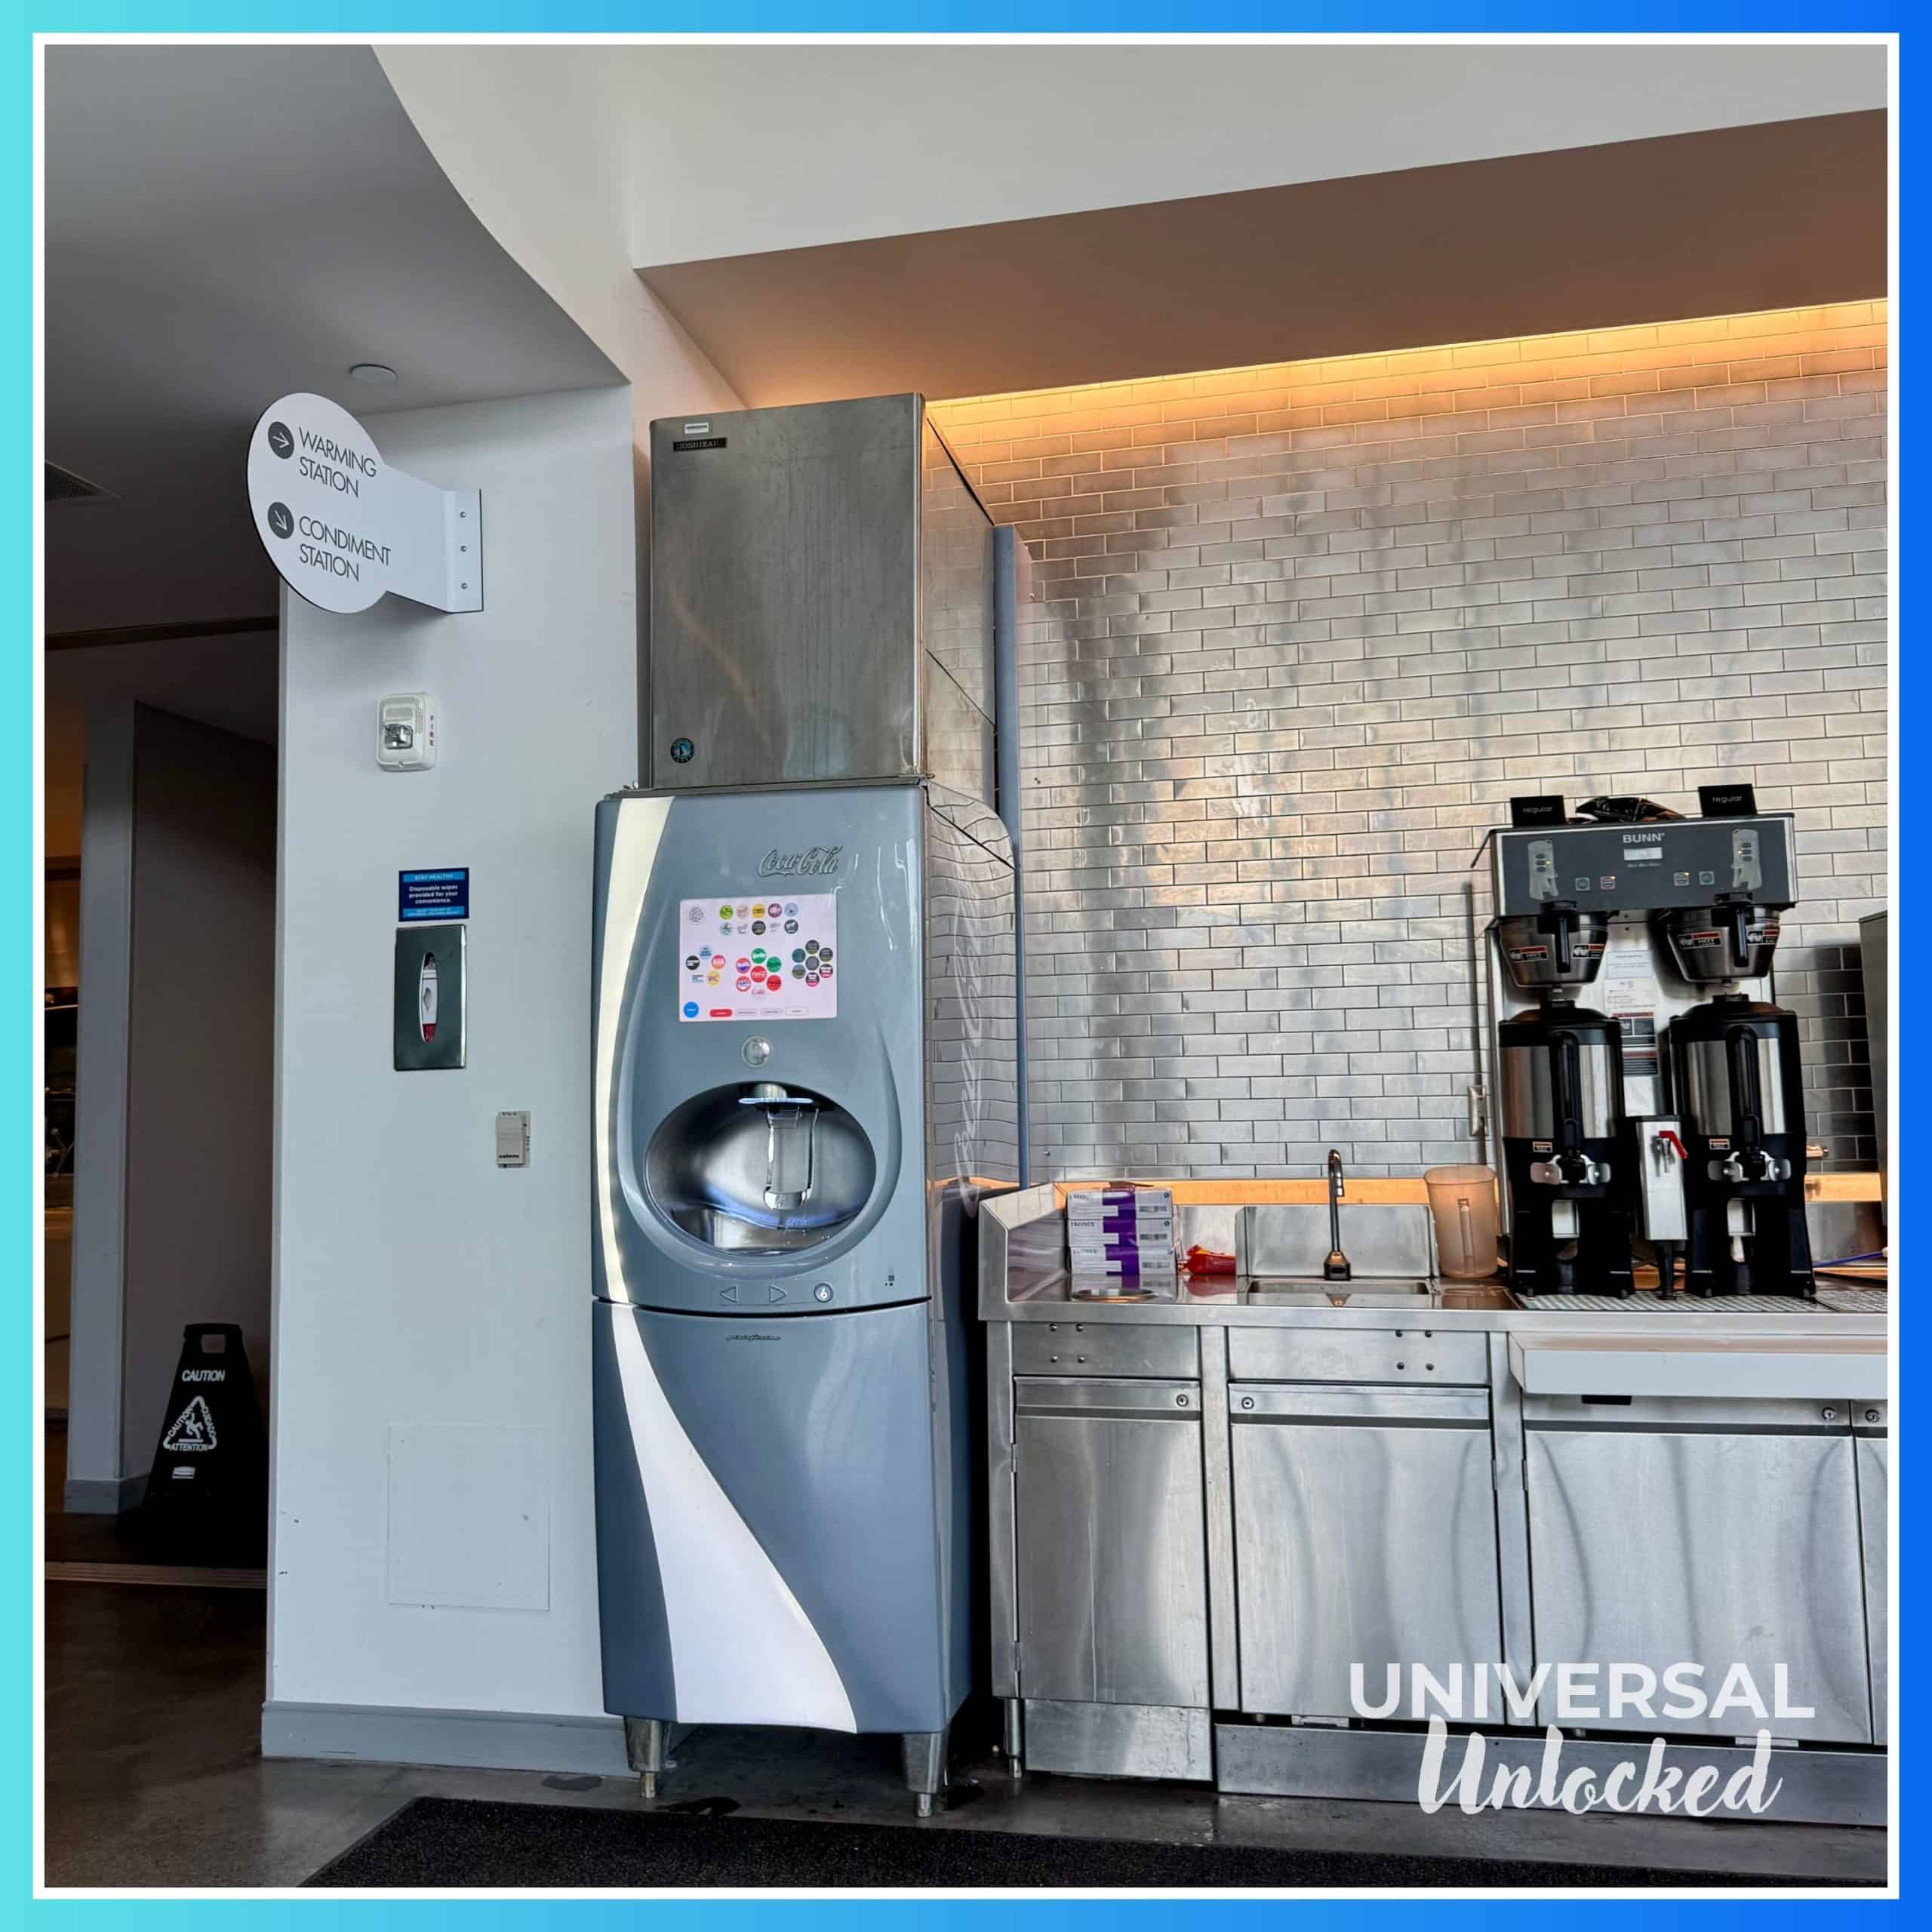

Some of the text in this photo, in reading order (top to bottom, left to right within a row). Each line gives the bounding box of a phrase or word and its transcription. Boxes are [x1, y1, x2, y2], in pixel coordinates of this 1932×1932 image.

[299, 426, 377, 477] WARMING
[299, 456, 359, 498] STATION
[299, 515, 392, 567] CONDIMENT
[299, 543, 360, 582] STATION
[1523, 805, 1552, 814] regular
[1712, 795, 1743, 804] regular
[1623, 832, 1661, 844] BUNN
[181, 1370, 226, 1382] CAUTION
[167, 1404, 194, 1438] CAUTION
[169, 1442, 210, 1452] ATTENTION
